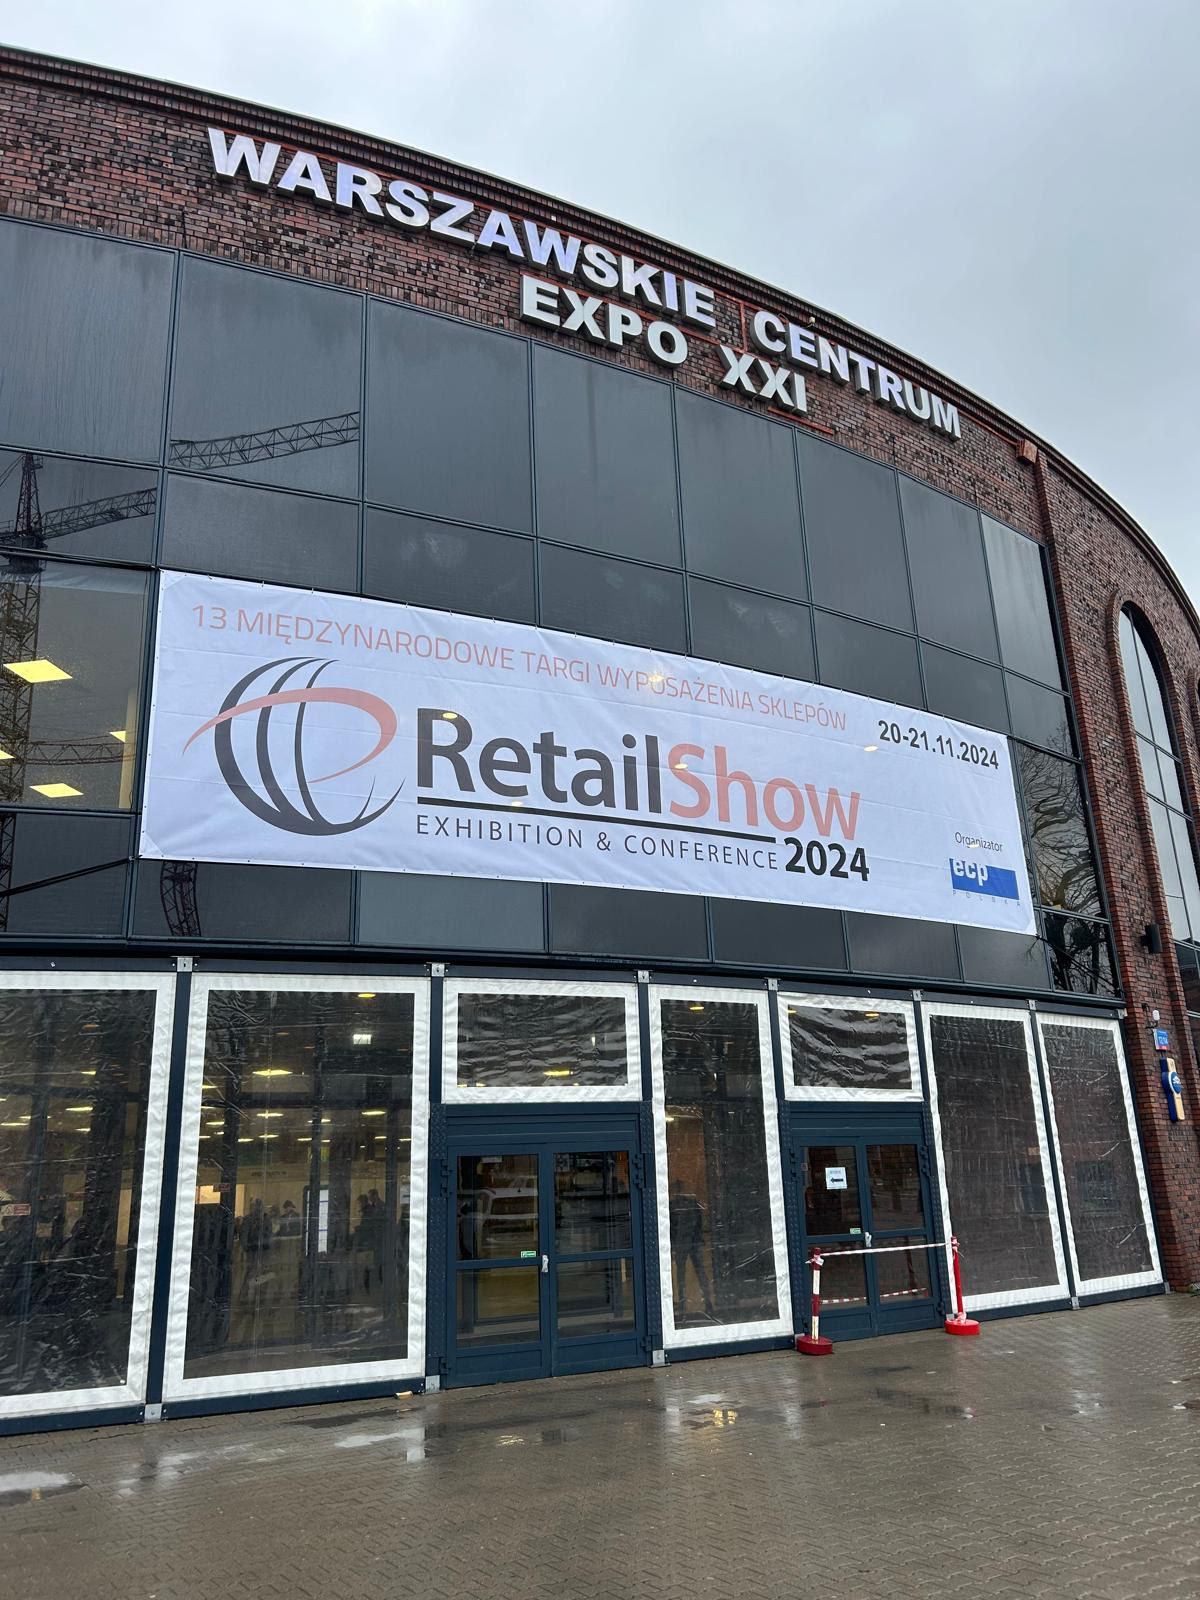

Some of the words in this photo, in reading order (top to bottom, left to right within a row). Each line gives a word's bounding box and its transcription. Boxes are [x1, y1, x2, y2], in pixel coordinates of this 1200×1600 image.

[207, 127, 716, 329] WARSZAWSKIE
[751, 309, 962, 440] CENTRUM
[519, 274, 688, 368] EXPO
[719, 344, 807, 413] XXI
[192, 605, 227, 630] 13
[237, 609, 514, 670] MIĘDZYNARODOWE
[521, 650, 590, 683] TARGI
[597, 663, 754, 711] WYPOSAŻENIA
[759, 694, 847, 731] SKLEPÓW
[417, 707, 861, 840] RetailShow
[878, 720, 999, 769] 20-21.11.2024
[417, 814, 583, 849] EXHIBITION
[596, 832, 612, 851] &
[624, 835, 779, 870] CONFERENCE
[783, 837, 870, 881] 2024
[952, 857, 989, 887] ecp
[954, 831, 1003, 852] Organizator
